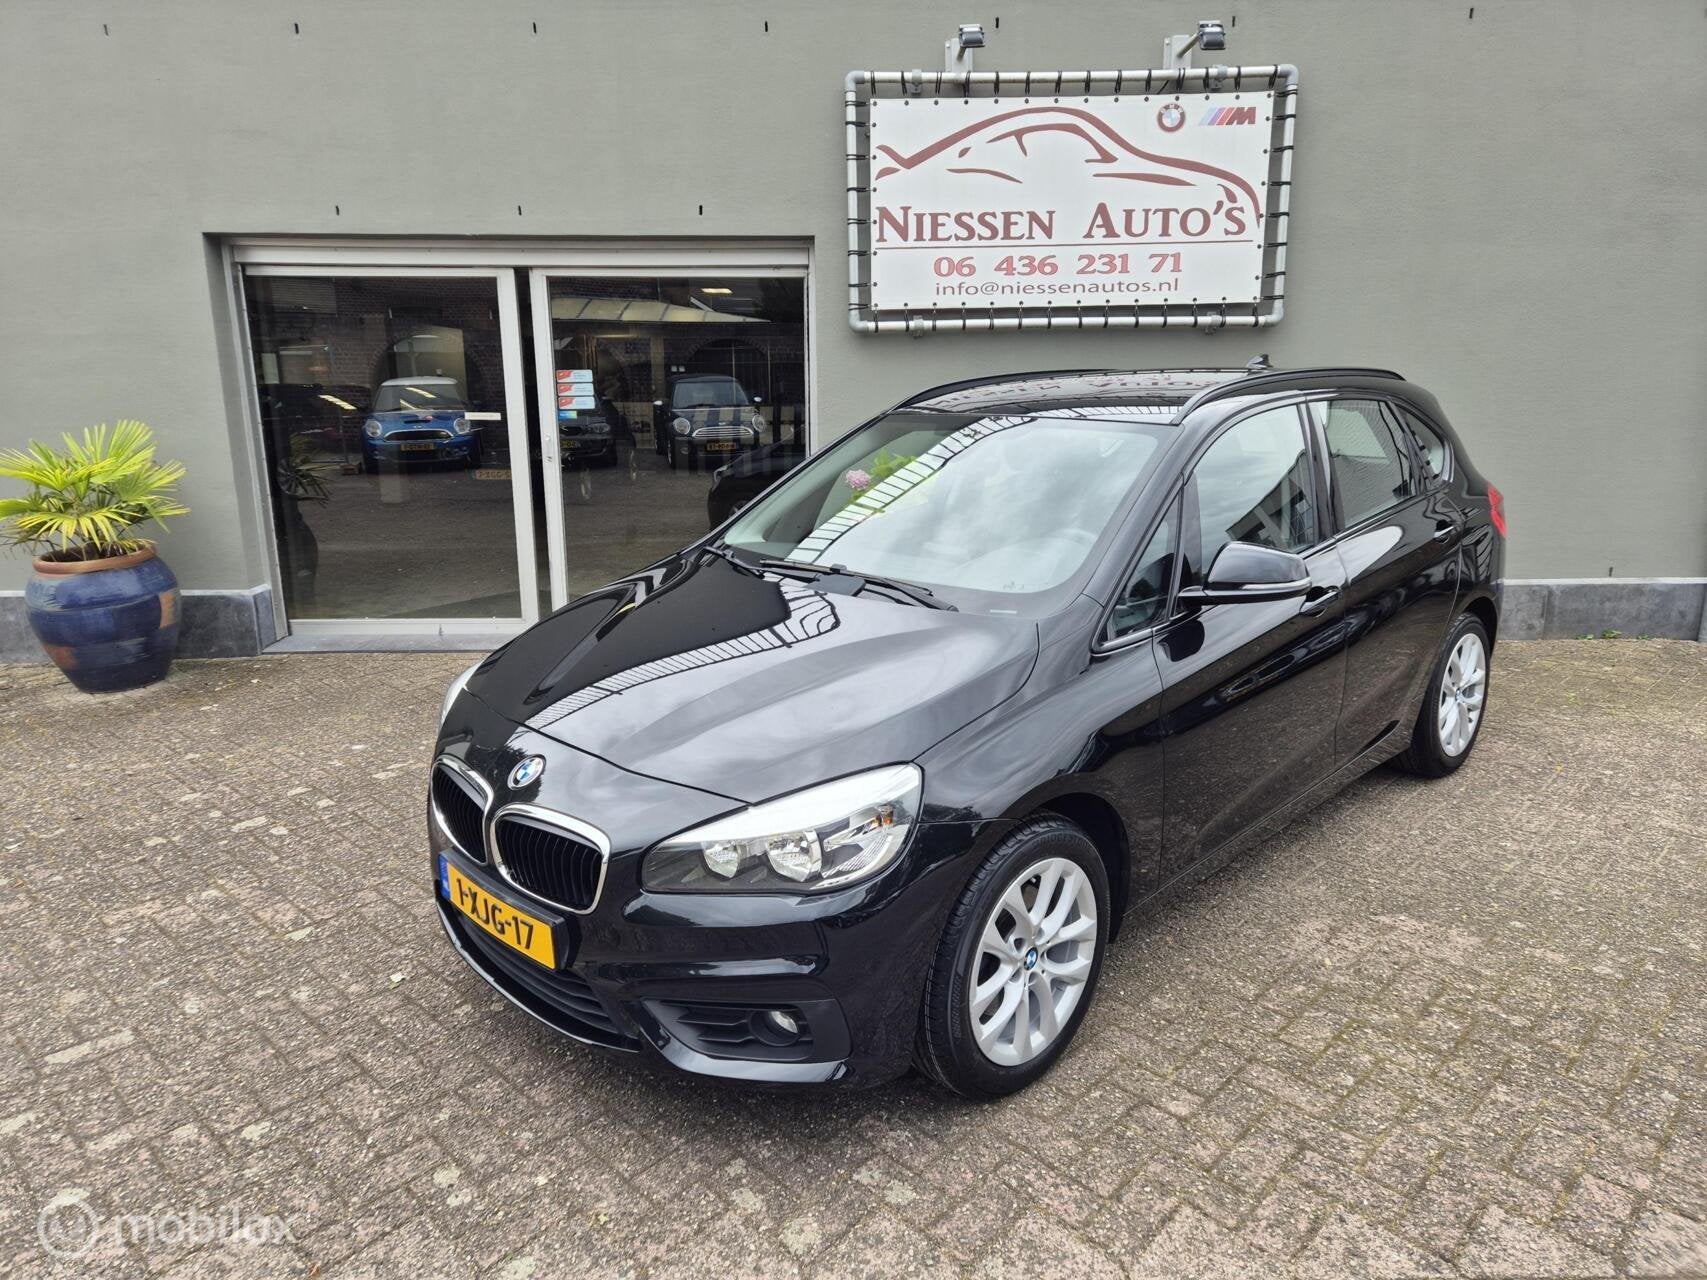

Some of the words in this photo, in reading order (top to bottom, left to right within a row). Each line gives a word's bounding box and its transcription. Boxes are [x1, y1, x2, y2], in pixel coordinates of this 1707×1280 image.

[875, 206, 1056, 243] NIESSEN
[1082, 200, 1246, 240] AUTO'S
[934, 256, 977, 278] 06
[994, 254, 1059, 276] 436
[1076, 253, 1131, 275] 231
[1148, 252, 1183, 274] 71
[935, 278, 1179, 297] info@niessenautos.nl
[456, 877, 534, 950] 1-XJG-17
